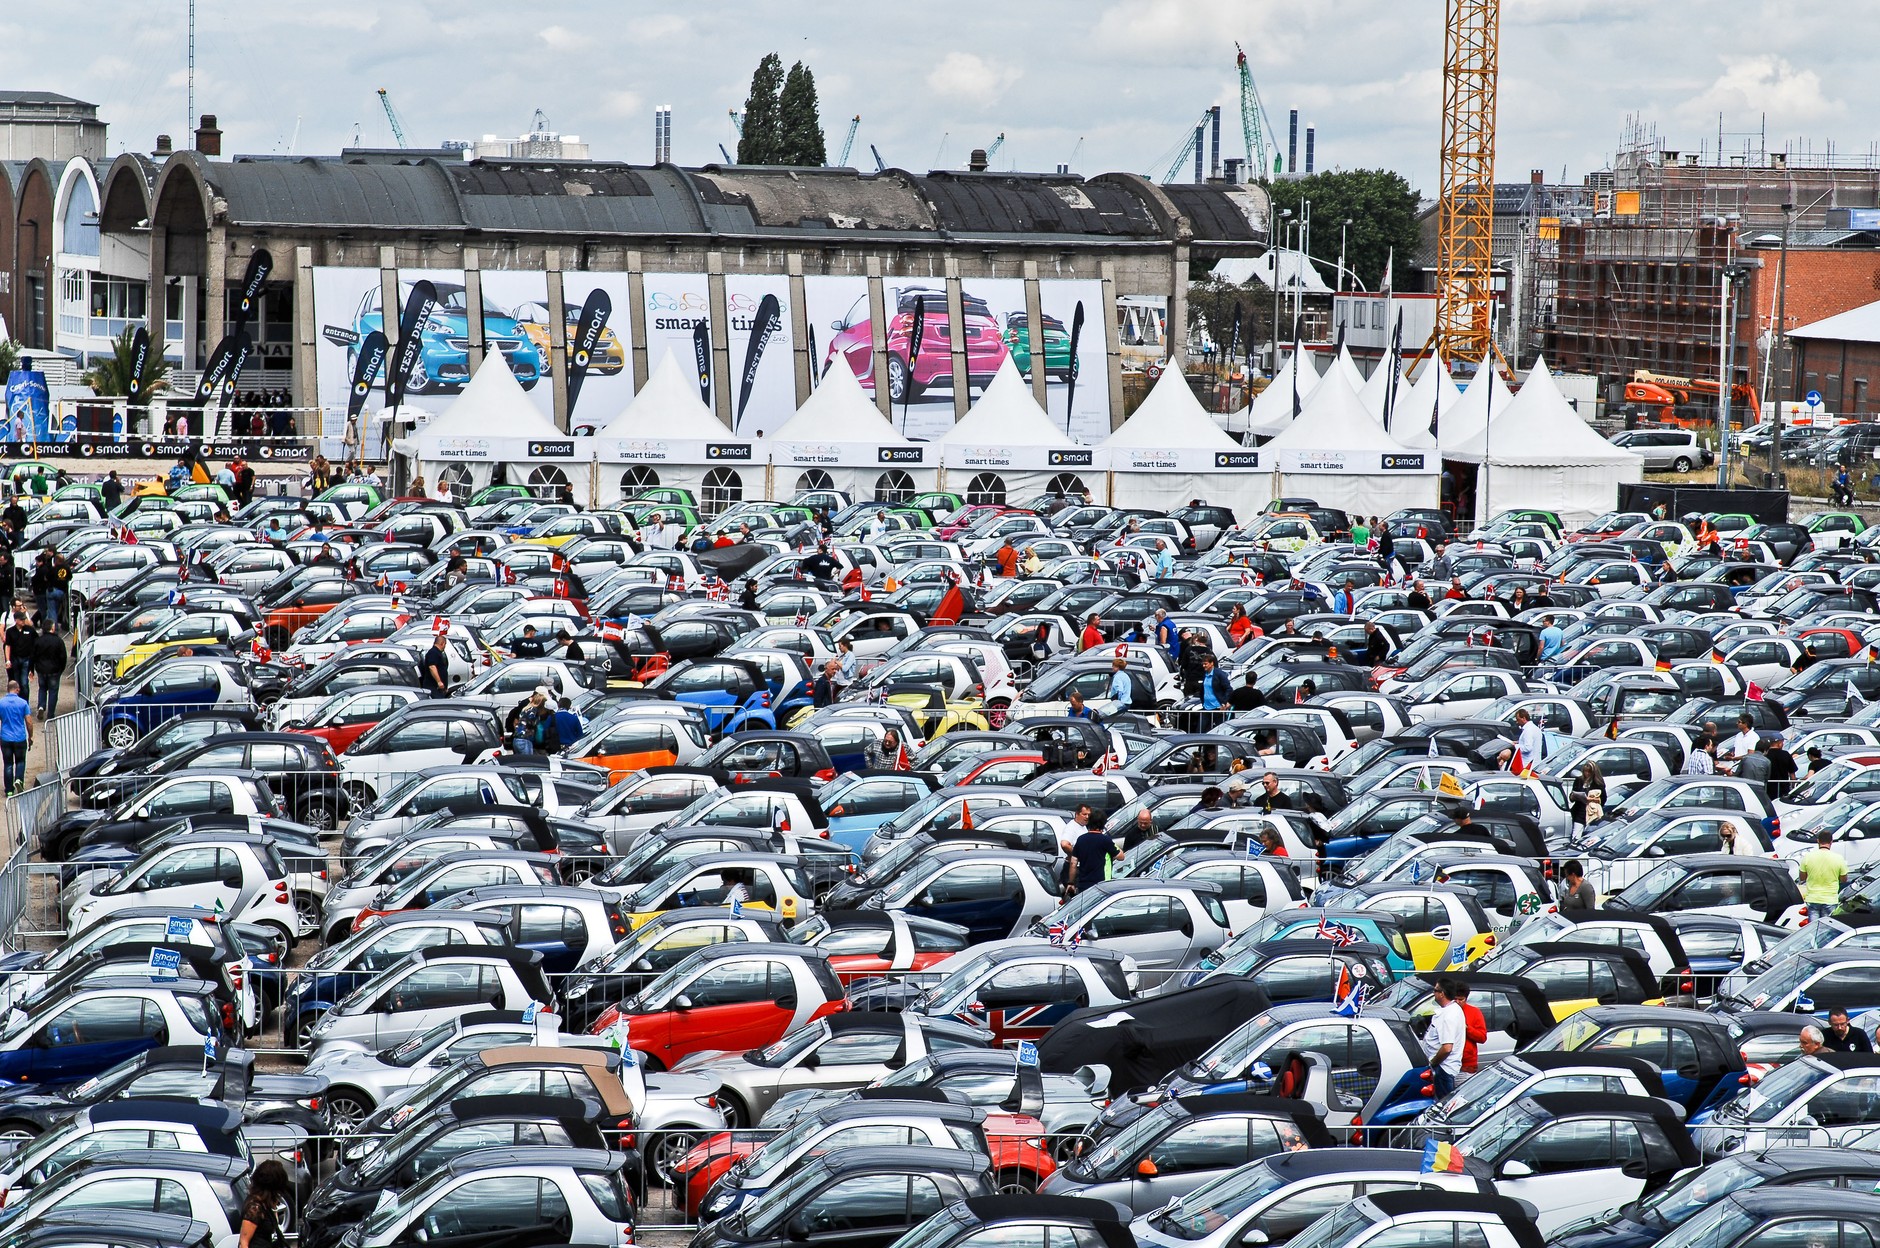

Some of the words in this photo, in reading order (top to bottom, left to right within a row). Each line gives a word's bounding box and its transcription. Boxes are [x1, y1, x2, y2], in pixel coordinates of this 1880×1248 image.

[246, 264, 268, 297] smart
[324, 327, 358, 341] entrance
[583, 308, 606, 350] smart
[400, 341, 417, 373] TEST
[411, 299, 434, 340] DRIVE
[745, 352, 760, 384] TEST
[757, 313, 778, 353] DRIVE
[133, 343, 147, 378] smart
[231, 347, 249, 381] smart
[362, 347, 384, 382] smart
[209, 350, 233, 384] smart
[36, 444, 70, 454] smart
[96, 444, 130, 454] smart
[156, 443, 190, 455] smart
[214, 445, 248, 456] smart
[274, 446, 308, 457] smart
[465, 449, 488, 457] times
[543, 445, 571, 453] smart
[721, 447, 748, 456] smart
[619, 451, 643, 459] smart
[644, 451, 666, 459] times
[893, 450, 920, 459] smart
[1063, 454, 1089, 462] smart
[1229, 455, 1255, 464] smart
[988, 458, 1010, 466] times
[1132, 460, 1155, 468] smart
[1155, 460, 1177, 468] times
[1323, 461, 1344, 469] times
[1395, 457, 1421, 466] smart
[170, 920, 192, 929] smart
[154, 952, 178, 963] smart
